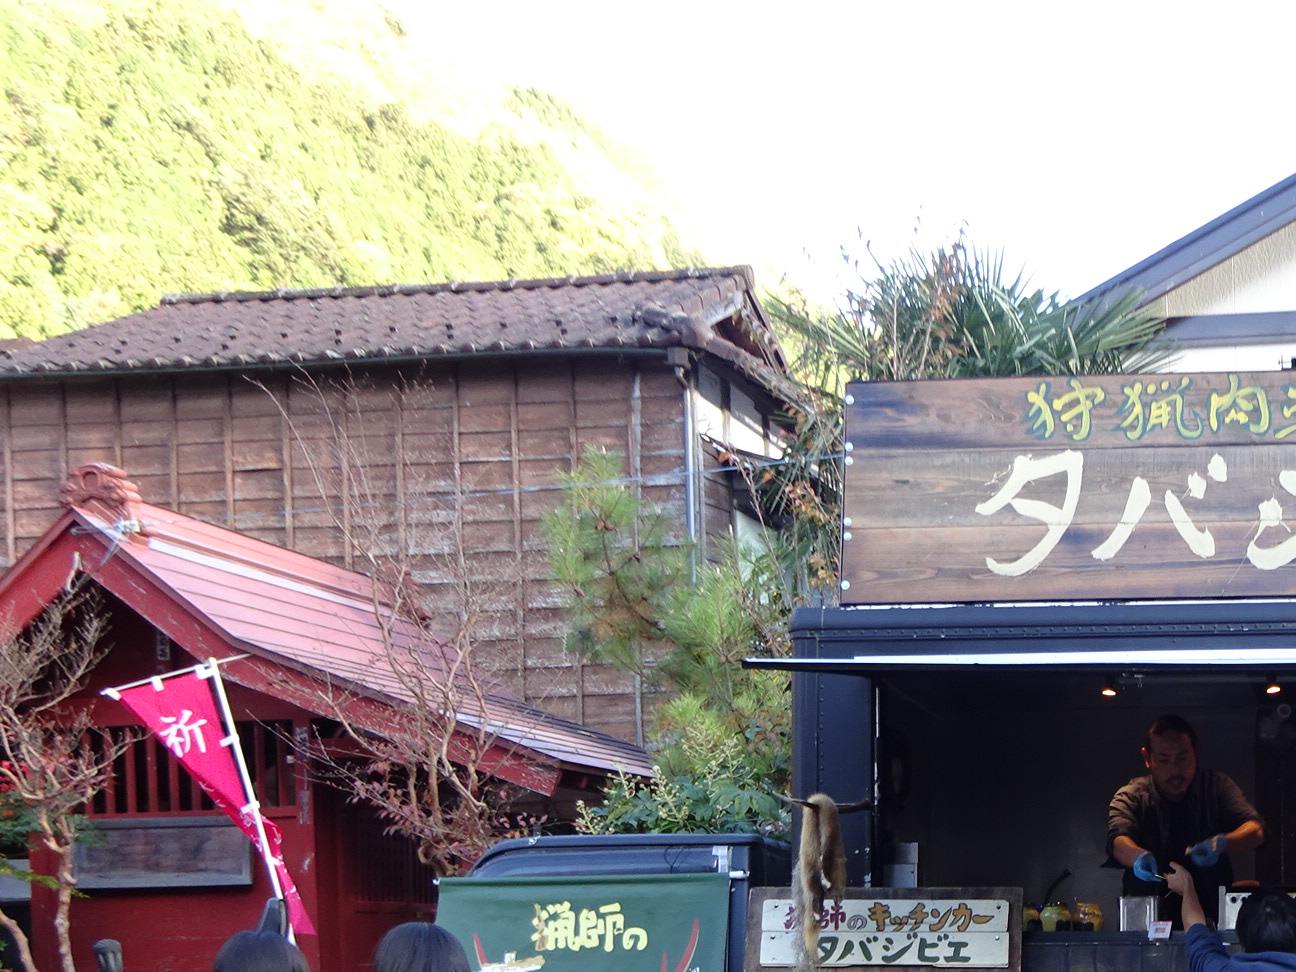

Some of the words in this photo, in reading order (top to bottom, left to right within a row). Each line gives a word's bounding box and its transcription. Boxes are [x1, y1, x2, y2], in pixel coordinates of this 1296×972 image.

[160, 710, 207, 758] 祈
[530, 900, 648, 952] 猟師の
[784, 901, 994, 932] 師のキッチンカー
[816, 932, 971, 963] タバジビエ
